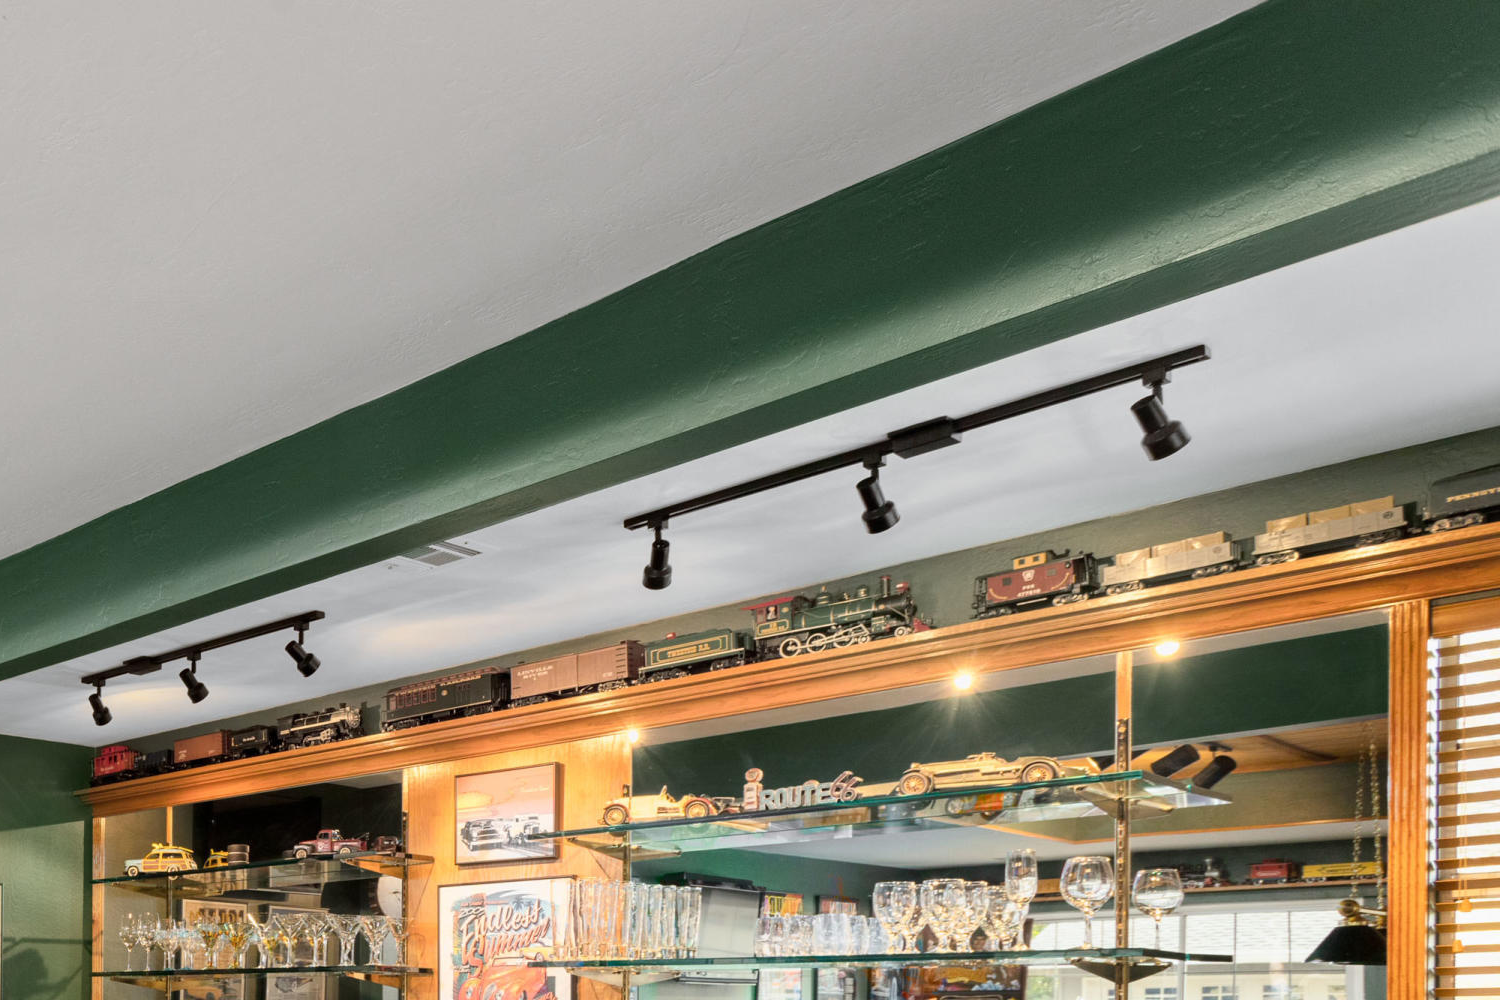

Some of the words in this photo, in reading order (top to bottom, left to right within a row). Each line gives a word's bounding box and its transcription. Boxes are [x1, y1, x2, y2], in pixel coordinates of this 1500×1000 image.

[760, 782, 832, 810] ROUTE
[830, 770, 864, 802] 66
[459, 898, 544, 966] Endless
[467, 917, 550, 979] Summer
